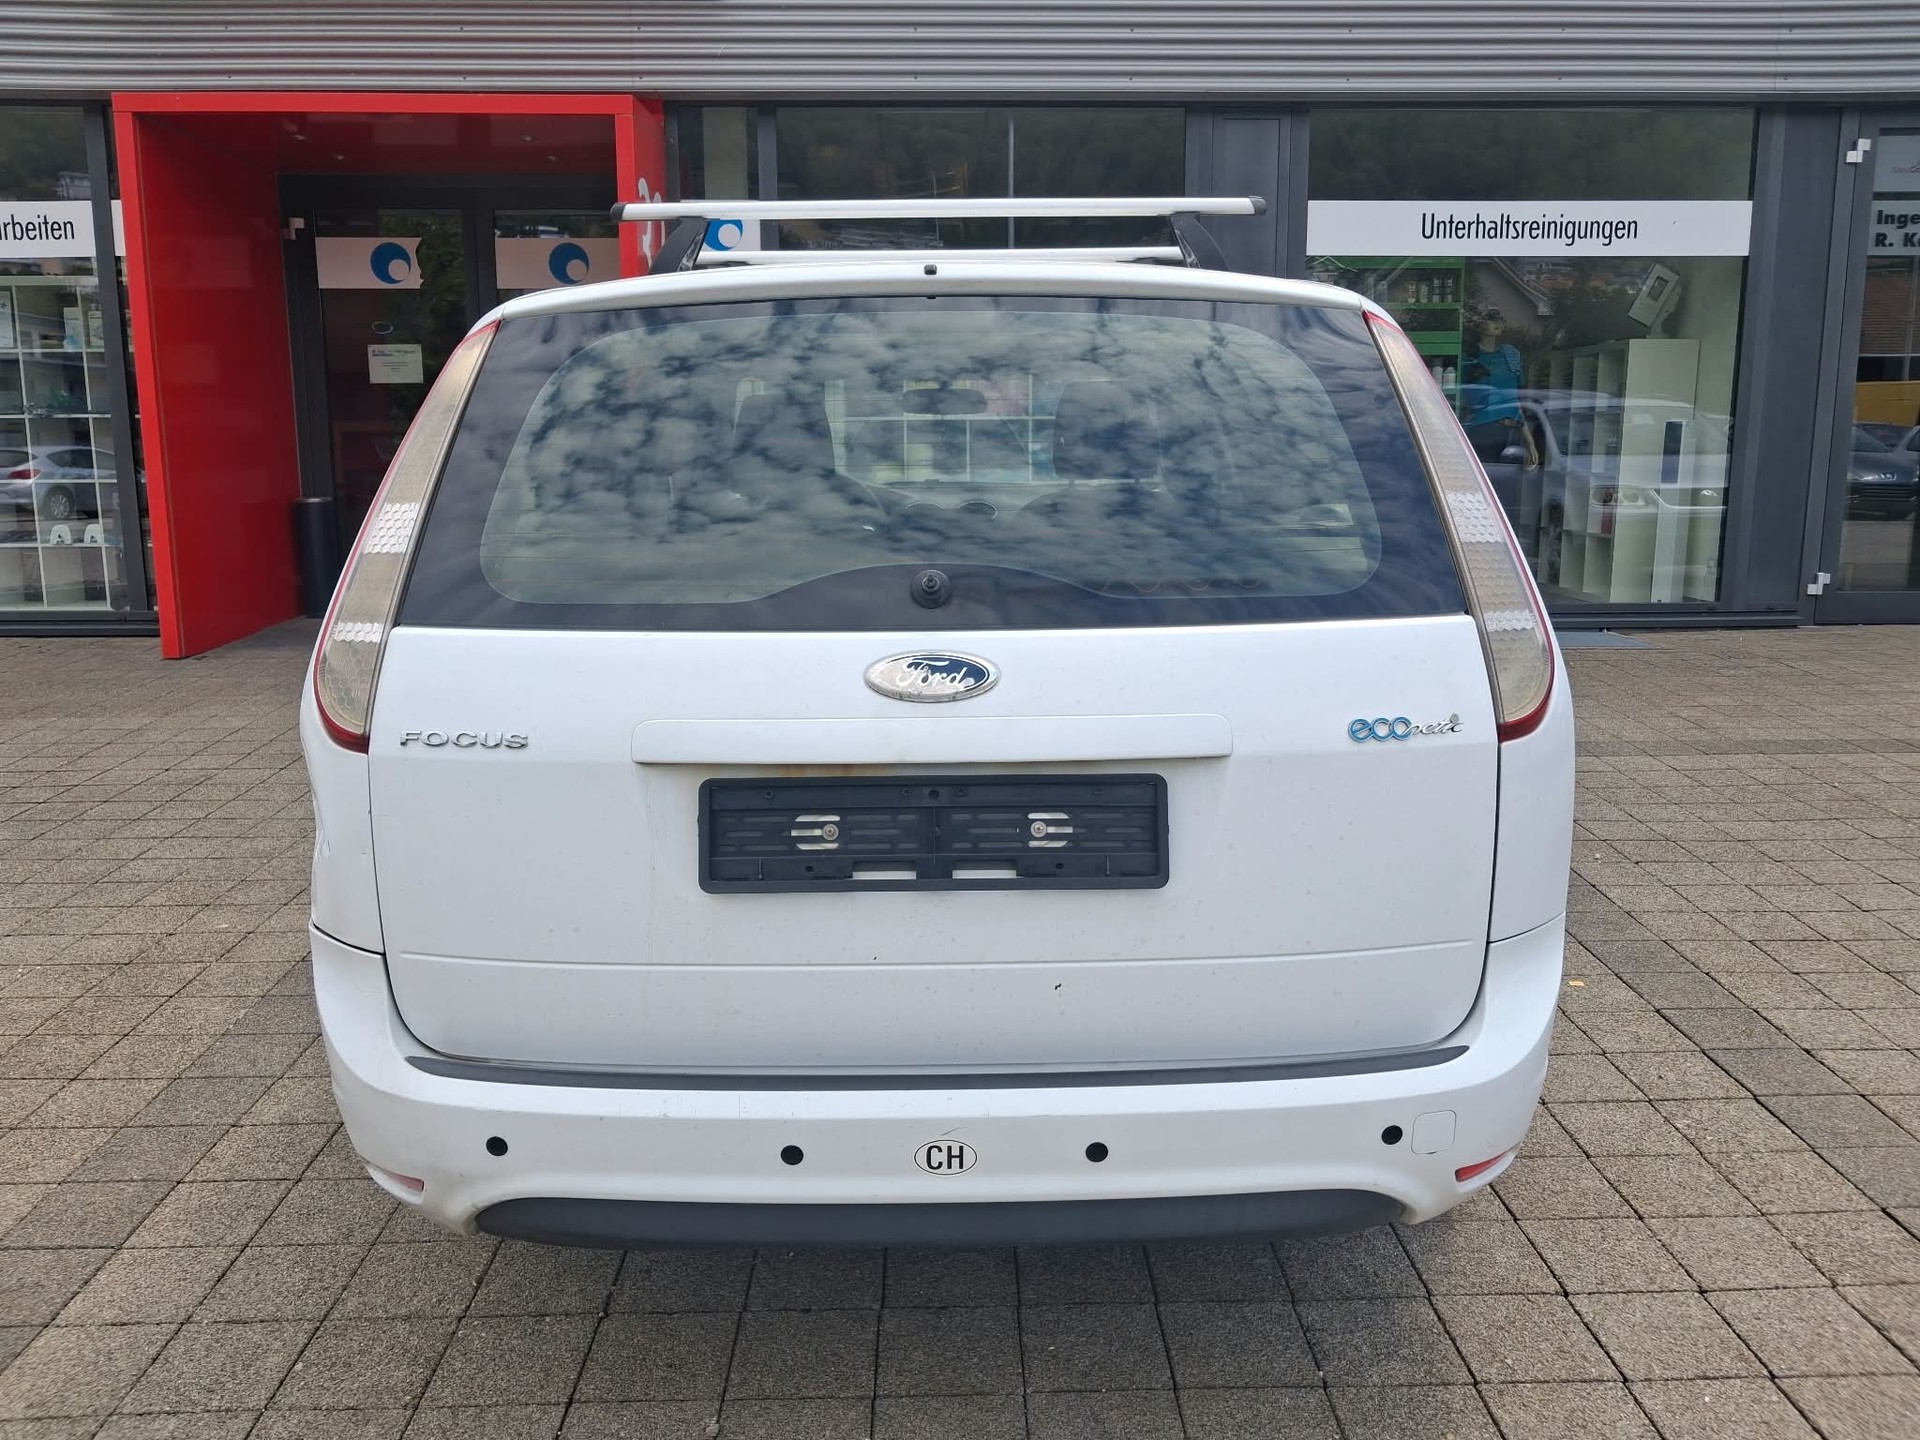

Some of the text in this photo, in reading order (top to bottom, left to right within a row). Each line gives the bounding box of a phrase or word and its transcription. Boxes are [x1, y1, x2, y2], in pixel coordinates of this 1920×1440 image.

[0, 214, 75, 241] rbeiten
[1421, 213, 1638, 246] Unterhaltsreinigungen
[1874, 232, 1920, 248] R. K
[896, 659, 975, 686] Ford
[400, 730, 528, 749] FOCUS
[926, 1145, 964, 1170] CH
